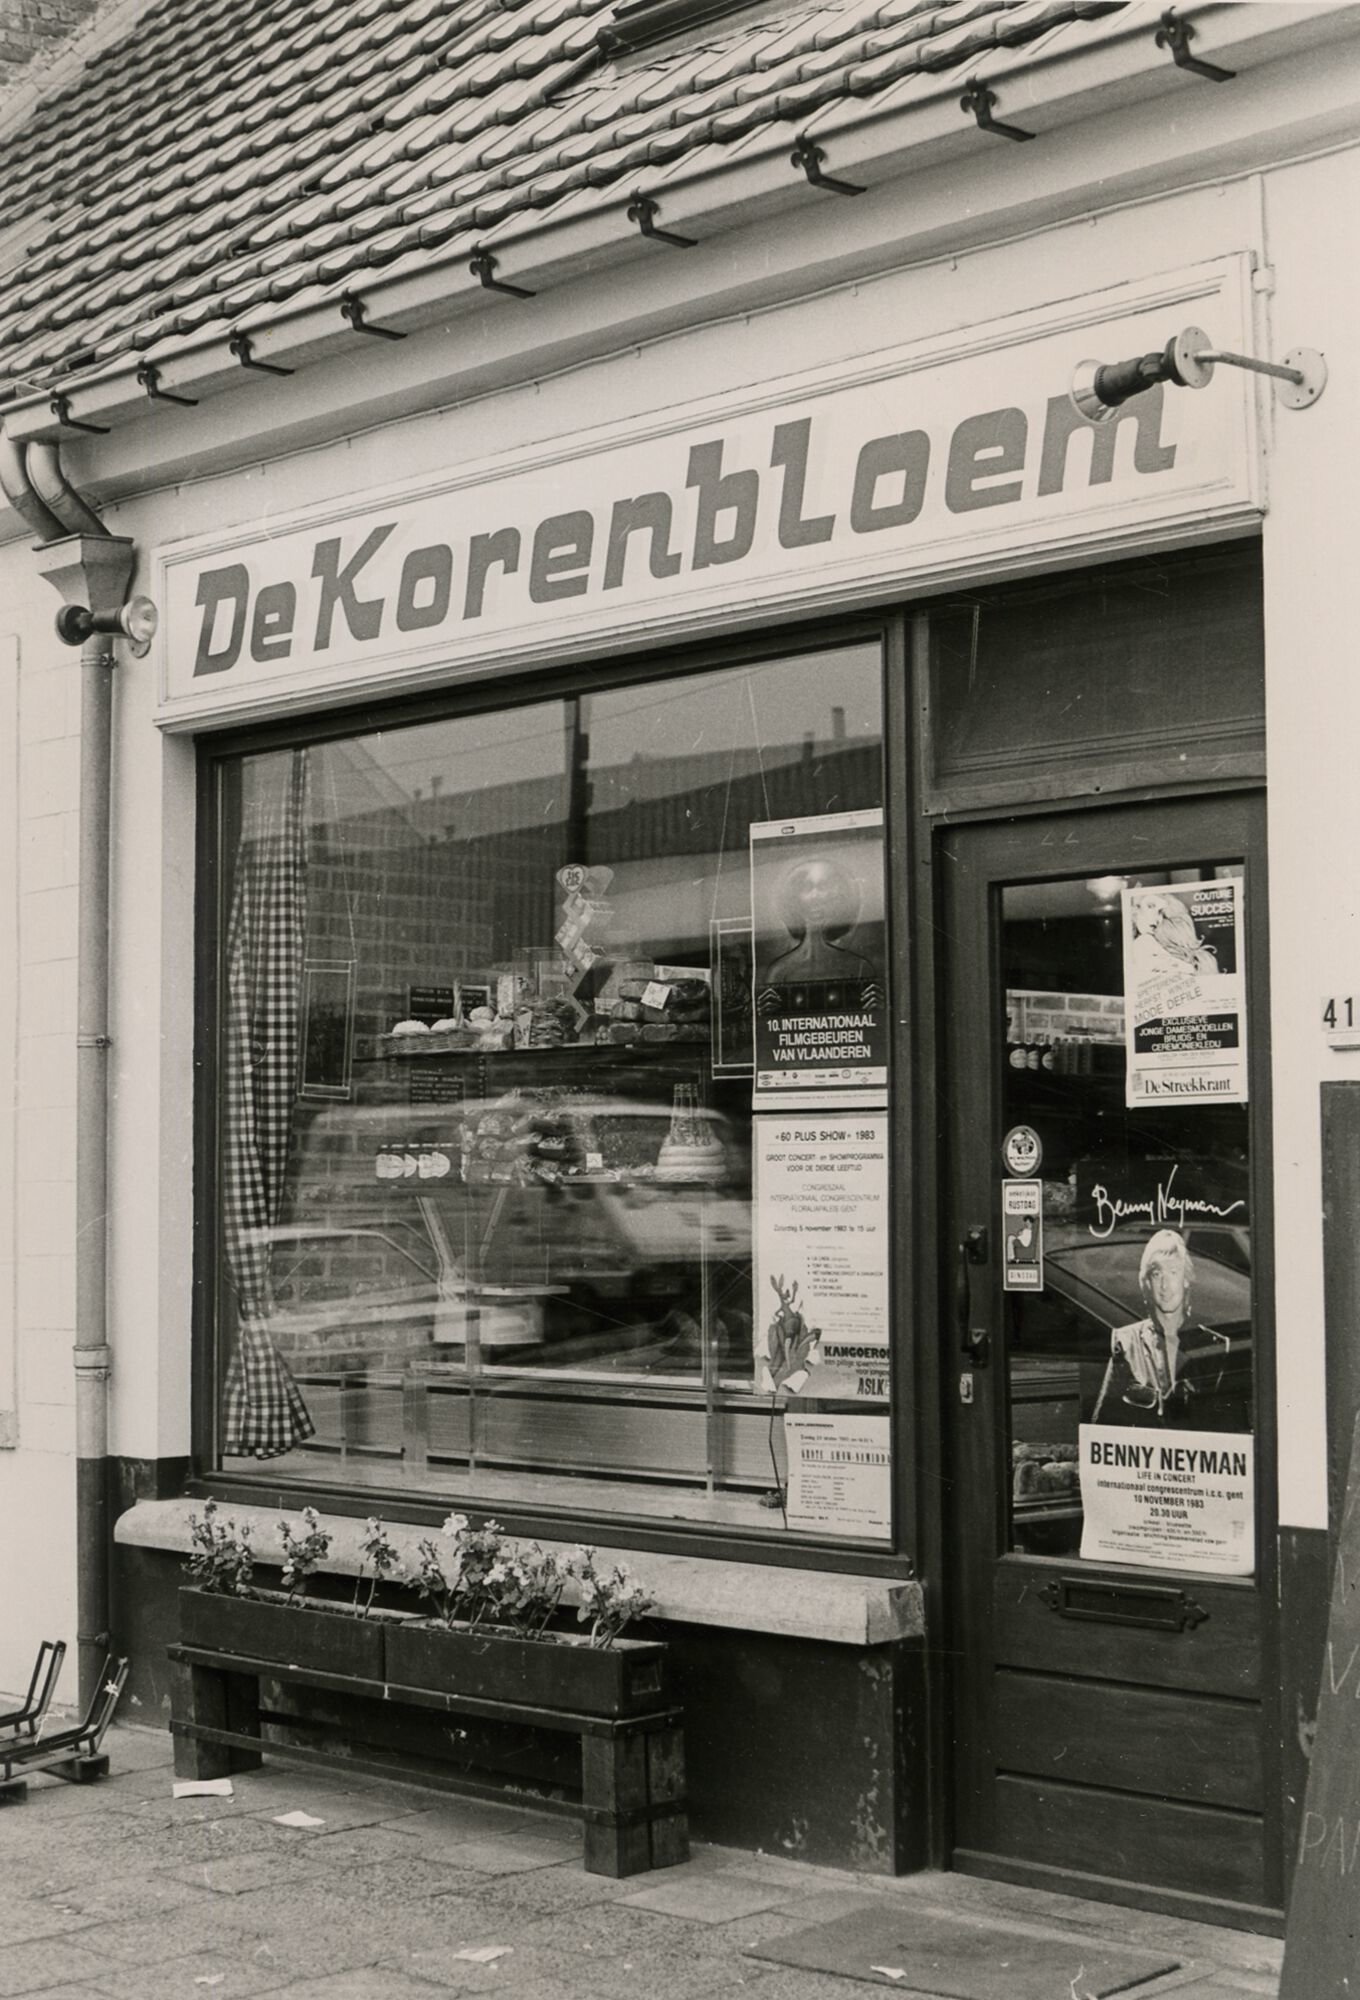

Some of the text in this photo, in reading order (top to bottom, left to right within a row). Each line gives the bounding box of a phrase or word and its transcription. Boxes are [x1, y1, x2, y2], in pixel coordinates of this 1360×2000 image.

[193, 383, 1177, 677] De Korenbloem
[1193, 888, 1233, 901] COUTURE
[1191, 902, 1234, 916] SUCCES
[1134, 1003, 1164, 1023] MODE
[1167, 986, 1202, 1010] DEFILE
[1162, 1015, 1209, 1026] EXCLUSIEVE
[1323, 997, 1353, 1029] 41
[767, 1014, 877, 1032] 10. INTERNATIONAAL
[1139, 1022, 1234, 1036] JONGE DAMESMODELLEN
[779, 1030, 864, 1046] FILMGEBEUREN
[1197, 1032, 1207, 1041] EN
[772, 1045, 872, 1061] VAN VLAANDEREN
[1145, 1077, 1231, 1094] De Streekkrant
[794, 1131, 816, 1141] PLUS
[855, 1130, 875, 1140] 1983
[857, 1377, 885, 1395] ASLK
[1090, 1442, 1247, 1476] BENNY NEYMAN
[1137, 1471, 1152, 1480] LIFE
[1163, 1473, 1196, 1484] CONCERT
[1096, 1479, 1146, 1491] internationaal
[1147, 1483, 1204, 1497] congrescentrum
[1133, 1494, 1204, 1509] 10 NOVEMBER 1983
[1171, 1509, 1188, 1519] UUR
